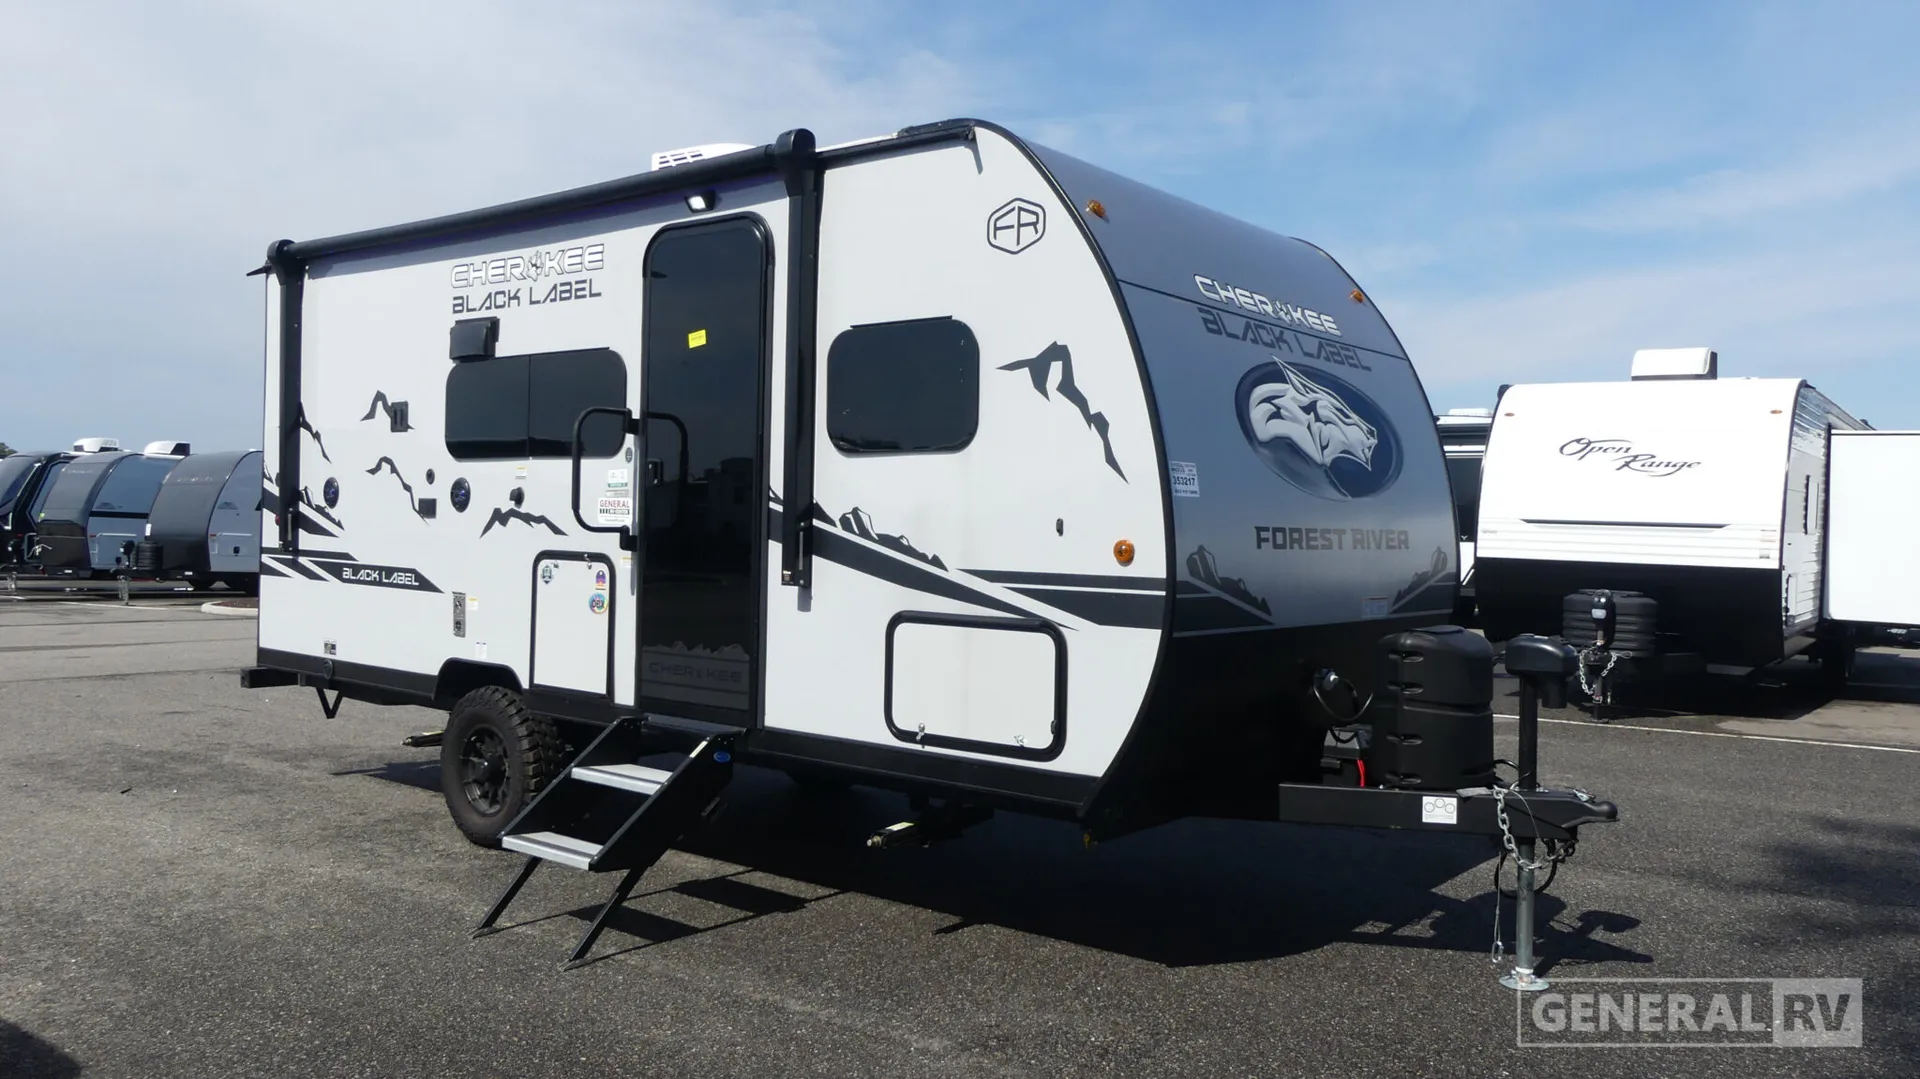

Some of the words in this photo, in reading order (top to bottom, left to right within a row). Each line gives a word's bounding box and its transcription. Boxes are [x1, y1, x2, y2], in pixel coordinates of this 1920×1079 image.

[452, 289, 521, 314] BLACK
[529, 278, 602, 306] LABEL
[1197, 307, 1294, 353] BLACK
[1293, 333, 1373, 372] LABEL
[1559, 437, 1633, 461] Open
[1611, 453, 1702, 477] Range
[599, 499, 630, 509] GENERAL
[1254, 526, 1347, 551] FOREST
[1350, 528, 1410, 551] RIVER
[342, 567, 380, 582] BLACK
[382, 571, 420, 586] LABEL
